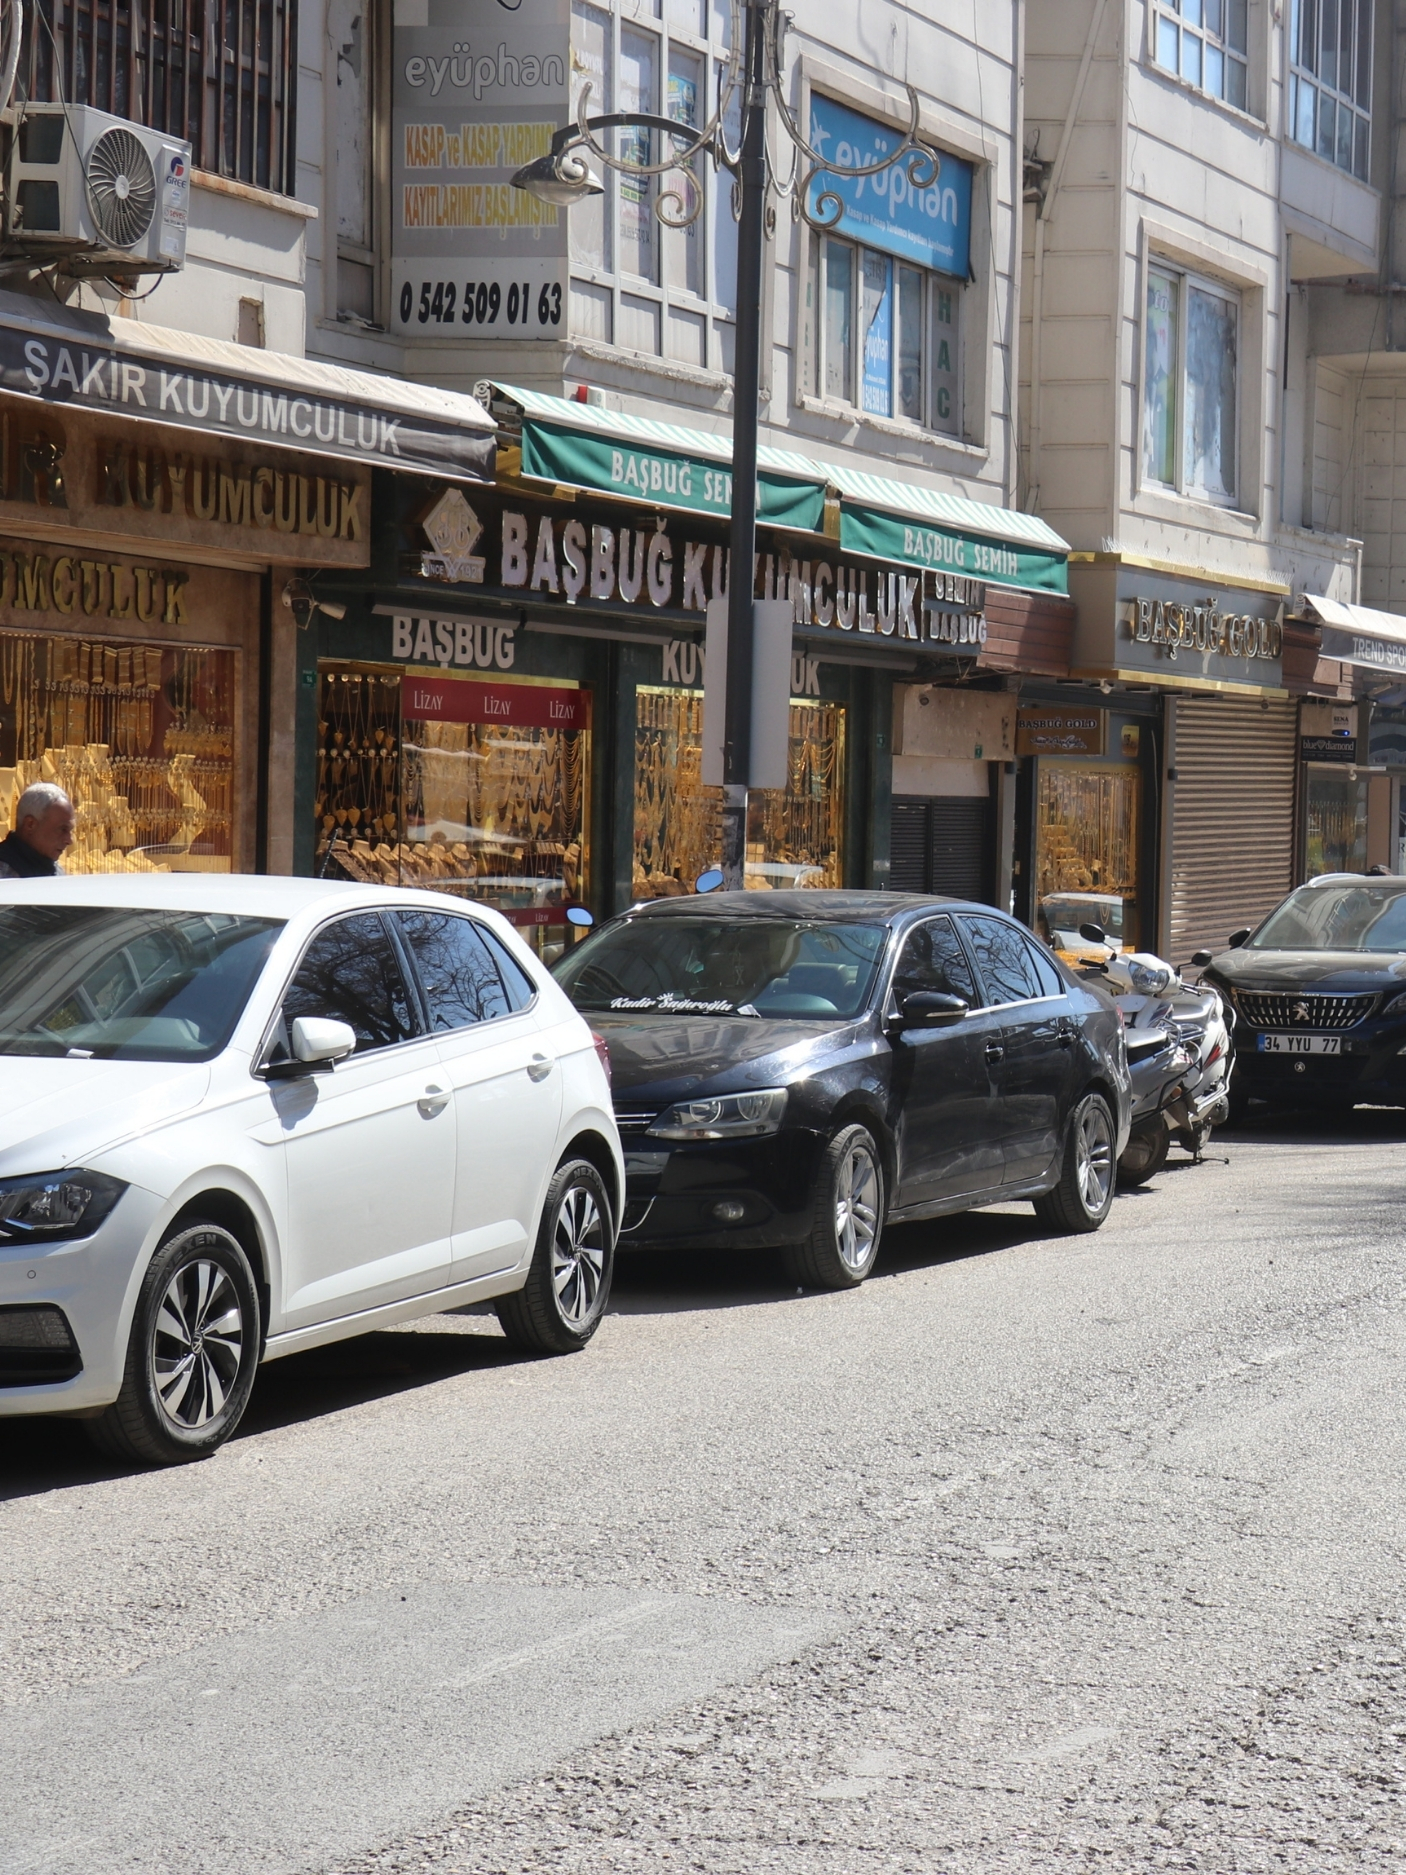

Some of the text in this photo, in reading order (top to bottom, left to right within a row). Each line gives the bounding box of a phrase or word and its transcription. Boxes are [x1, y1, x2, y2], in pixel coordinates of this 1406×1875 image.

[404, 42, 565, 101] eyüphan
[405, 124, 445, 168] KASAP
[446, 133, 460, 168] ve
[461, 124, 501, 168] KASAP
[166, 175, 187, 189] GREE
[835, 137, 958, 227] eyüphan
[404, 184, 483, 228] KAYITLARIMIZ
[401, 281, 562, 325] 0 542 509 01 63
[24, 339, 402, 456] ŞAKİR KUYUMCULUK
[98, 440, 363, 543] KUYUMCULUK
[611, 450, 693, 500] BAŞBUĞ
[459, 565, 483, 580] 1921
[502, 509, 673, 607] BAŞBUĞ
[904, 527, 1019, 579] BAŞBUĞ SEMİH
[1136, 597, 1284, 660] BAŞBUĞ GOLD
[1352, 636, 1386, 664] TREND
[1020, 717, 1097, 730] BAŞBUĞ GOLD
[1303, 739, 1354, 751] blue diamond
[610, 996, 734, 1014] Kadir Sağıroğlu
[1264, 1036, 1339, 1053] 34 YYU 77
